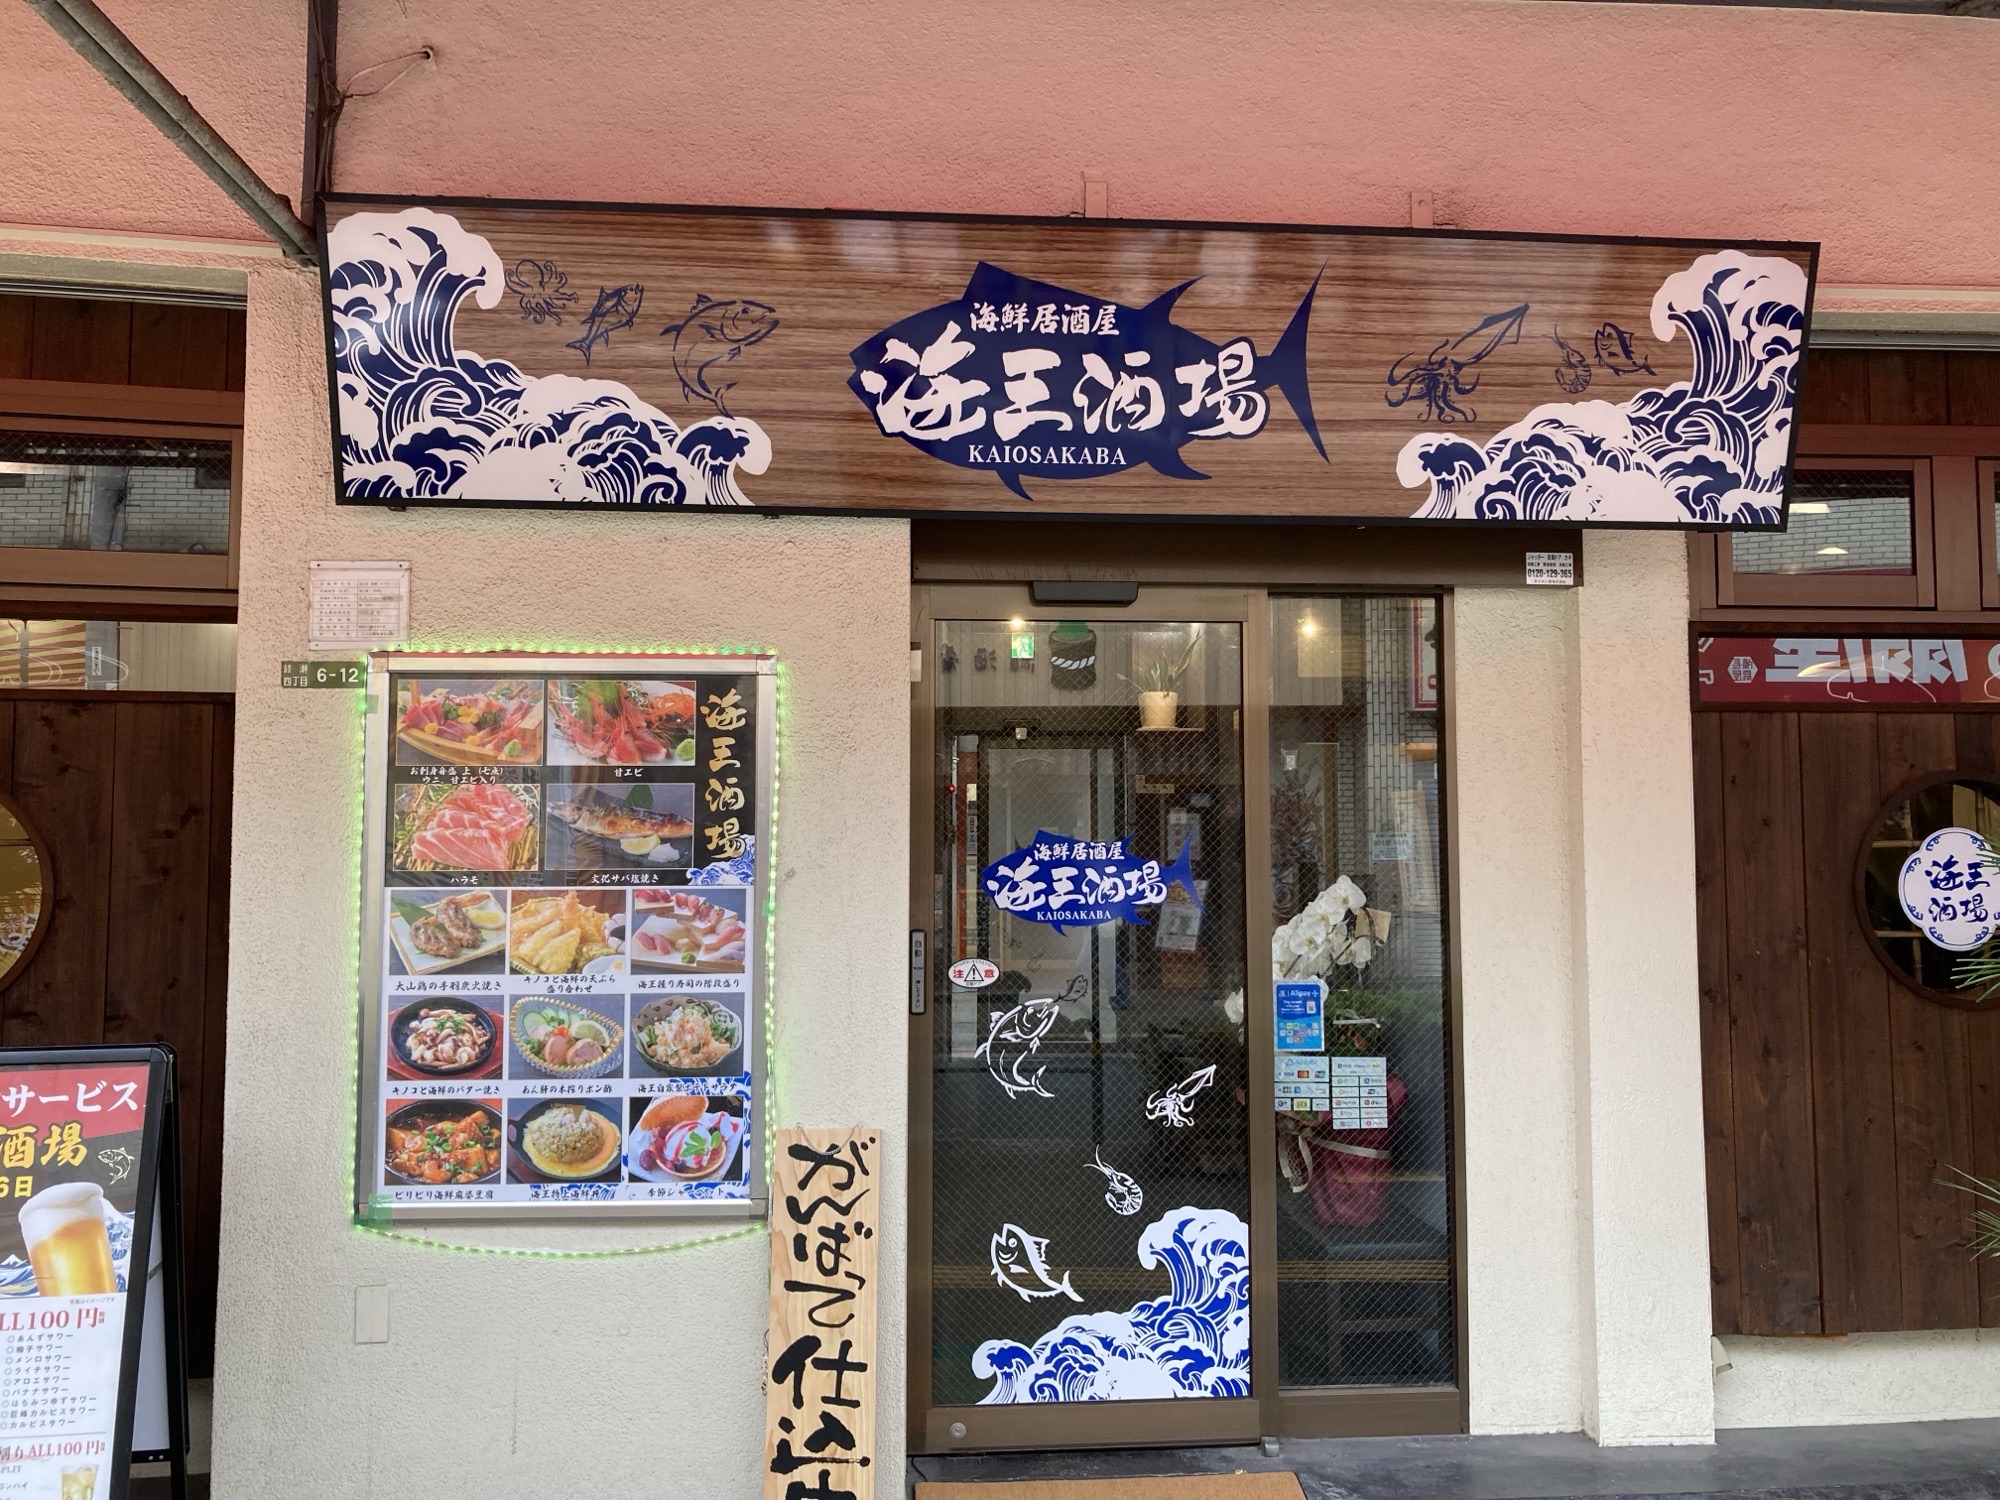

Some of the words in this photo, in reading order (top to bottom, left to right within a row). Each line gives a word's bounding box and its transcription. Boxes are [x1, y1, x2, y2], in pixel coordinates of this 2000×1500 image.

[970, 302, 1120, 337] 海鮮居酒屋
[861, 320, 1267, 441] 海王酒場
[968, 445, 1127, 466] KAIOSAKABA
[283, 676, 308, 687] 四丁目
[316, 667, 359, 683] 6-12
[614, 767, 643, 778] 甘エビ
[700, 687, 746, 859] 海王酒場
[1033, 840, 1125, 862] 海鮮居酒屋
[450, 875, 479, 885] ハラモ
[591, 873, 660, 884] 文化サバ塩焼き
[986, 857, 1168, 910] 海王酒場
[1036, 910, 1112, 922] KAIOSAKABA
[1928, 893, 1988, 923] 酒場
[546, 984, 593, 993] 盛り合わせ
[1, 1080, 139, 1118] サービス
